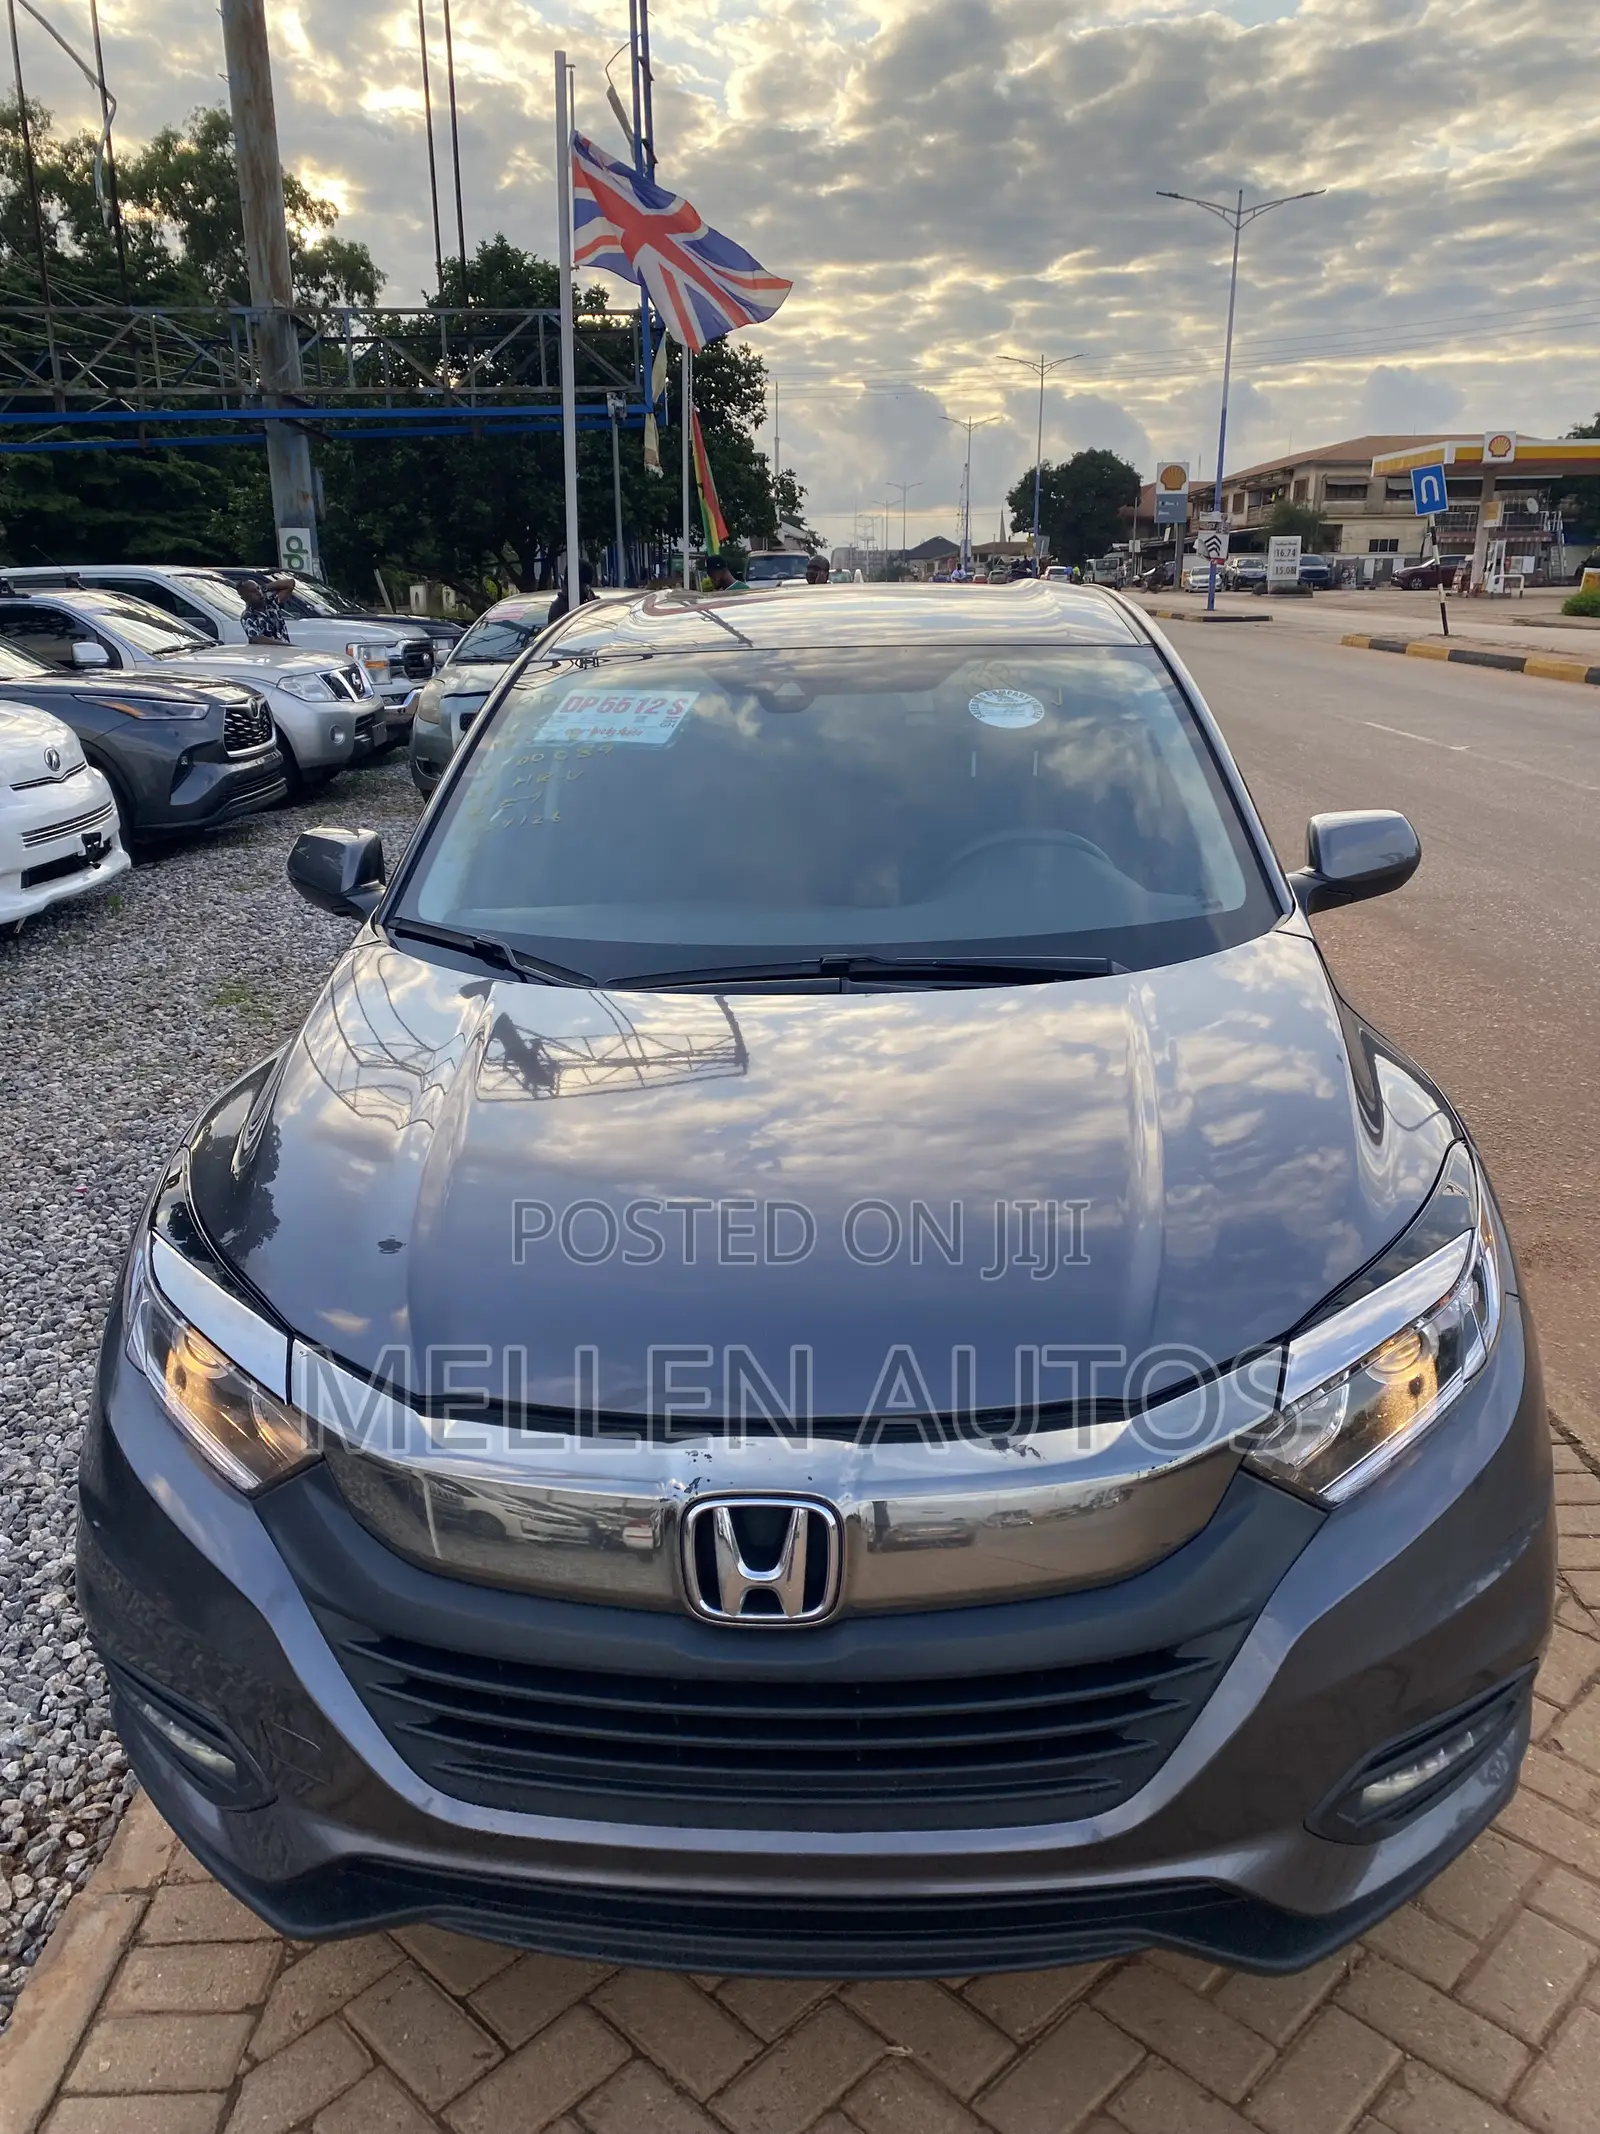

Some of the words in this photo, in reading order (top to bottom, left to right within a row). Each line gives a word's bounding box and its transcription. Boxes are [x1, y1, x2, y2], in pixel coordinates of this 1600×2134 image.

[560, 696, 598, 713] DP
[597, 697, 668, 714] 5512
[666, 698, 689, 715] S
